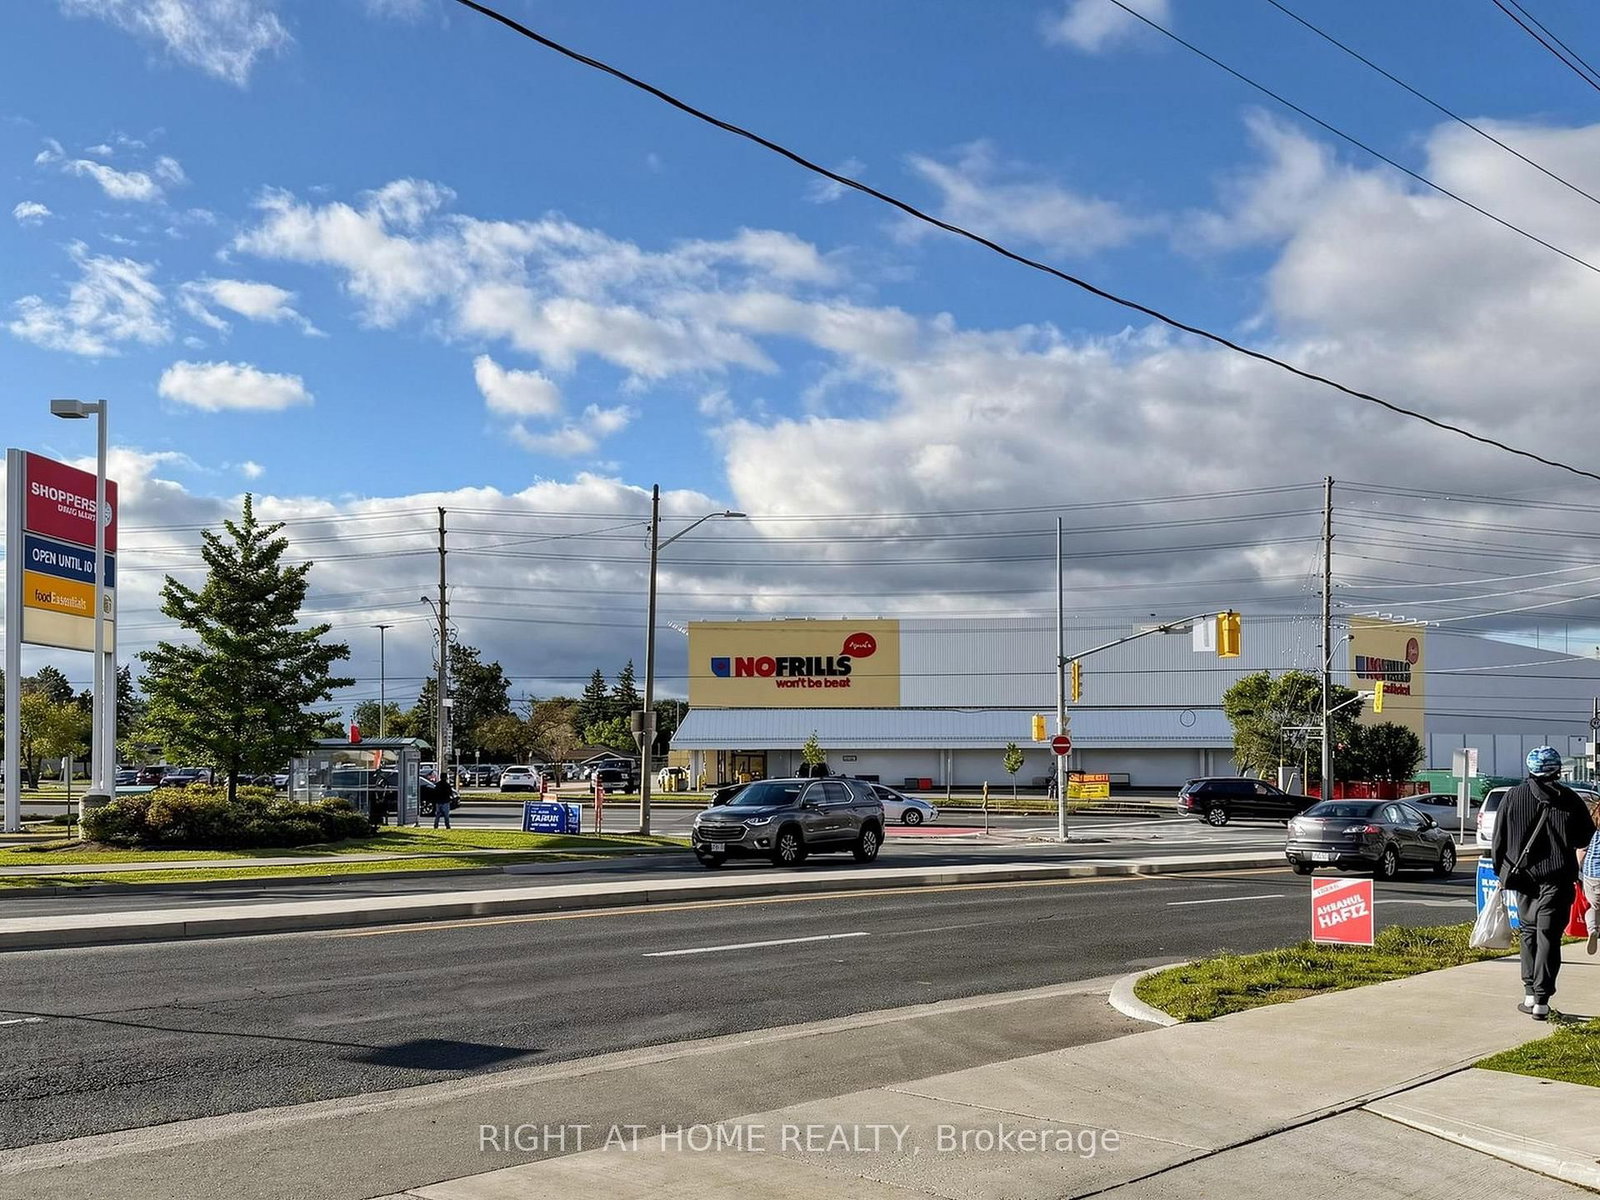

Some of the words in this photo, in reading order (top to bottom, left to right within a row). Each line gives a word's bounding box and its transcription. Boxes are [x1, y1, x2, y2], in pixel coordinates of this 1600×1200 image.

[31, 482, 96, 513] SHOPPERS
[32, 548, 56, 565] OPEN
[58, 554, 82, 571] UNTIL
[84, 560, 93, 573] 10
[776, 678, 807, 688] won't
[808, 678, 822, 688] be
[824, 677, 851, 688] beat
[1318, 902, 1369, 929] HAFIZ
